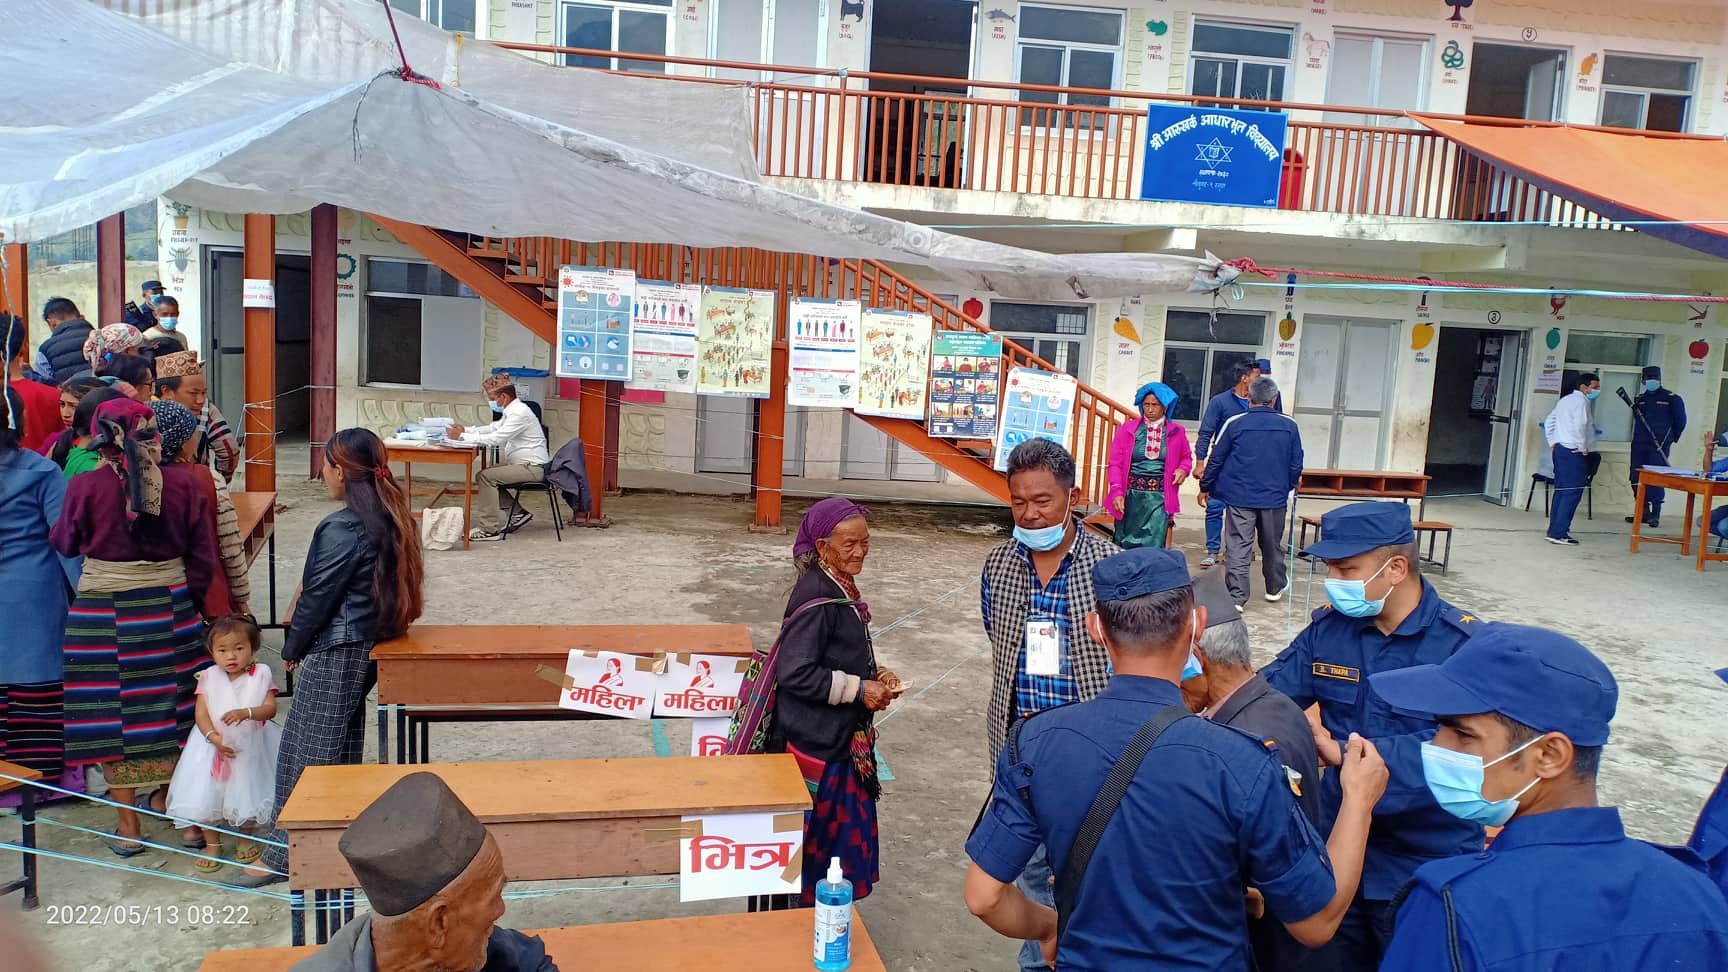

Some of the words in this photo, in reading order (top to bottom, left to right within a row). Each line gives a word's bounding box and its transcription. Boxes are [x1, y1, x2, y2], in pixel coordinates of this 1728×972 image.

[1150, 132, 1165, 150] श्री
[1201, 114, 1247, 135] आधारभूत
[570, 685, 646, 710] महिला
[663, 688, 735, 711] महिला
[689, 835, 794, 872] मित्र
